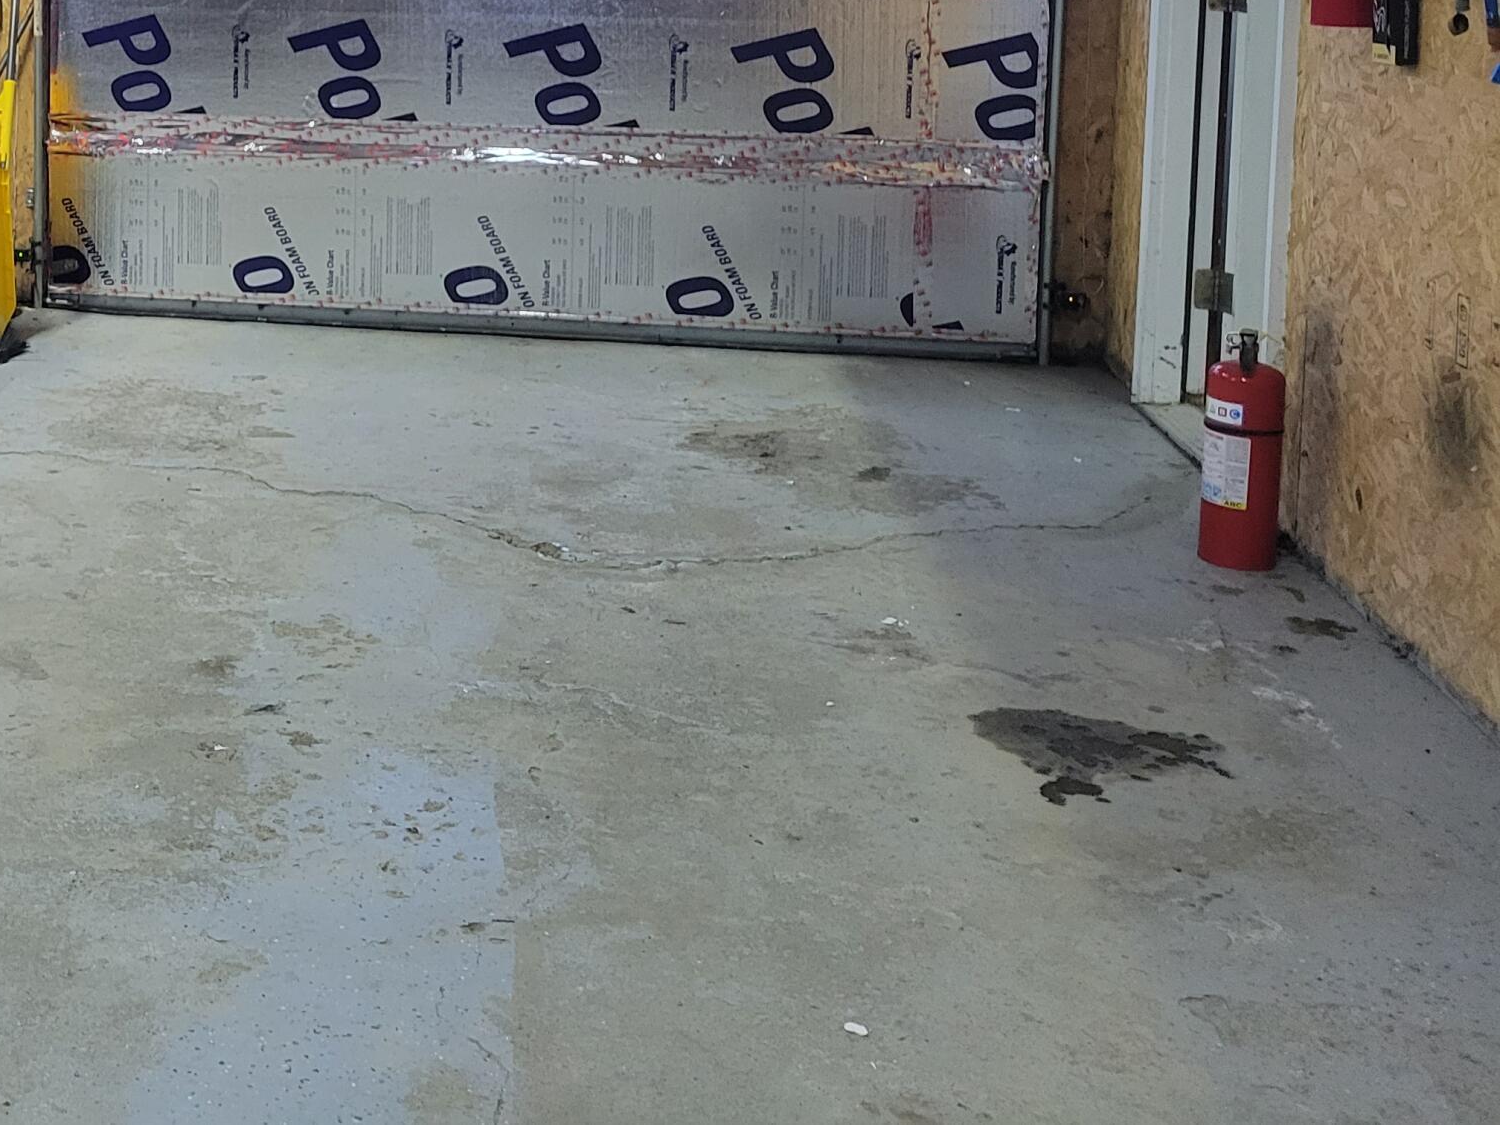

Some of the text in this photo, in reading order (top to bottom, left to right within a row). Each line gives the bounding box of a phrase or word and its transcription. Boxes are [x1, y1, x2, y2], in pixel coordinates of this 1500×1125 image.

[82, 14, 206, 114] Po
[287, 19, 418, 121] Po
[503, 23, 639, 127] Po
[730, 27, 874, 136] Po
[62, 198, 115, 286] ON FOAM BOARD
[264, 207, 293, 245] BOARD
[285, 246, 311, 279] FOAM
[477, 215, 536, 308] ON FOAM BOARD
[701, 225, 762, 321] ON FOAM BOARD
